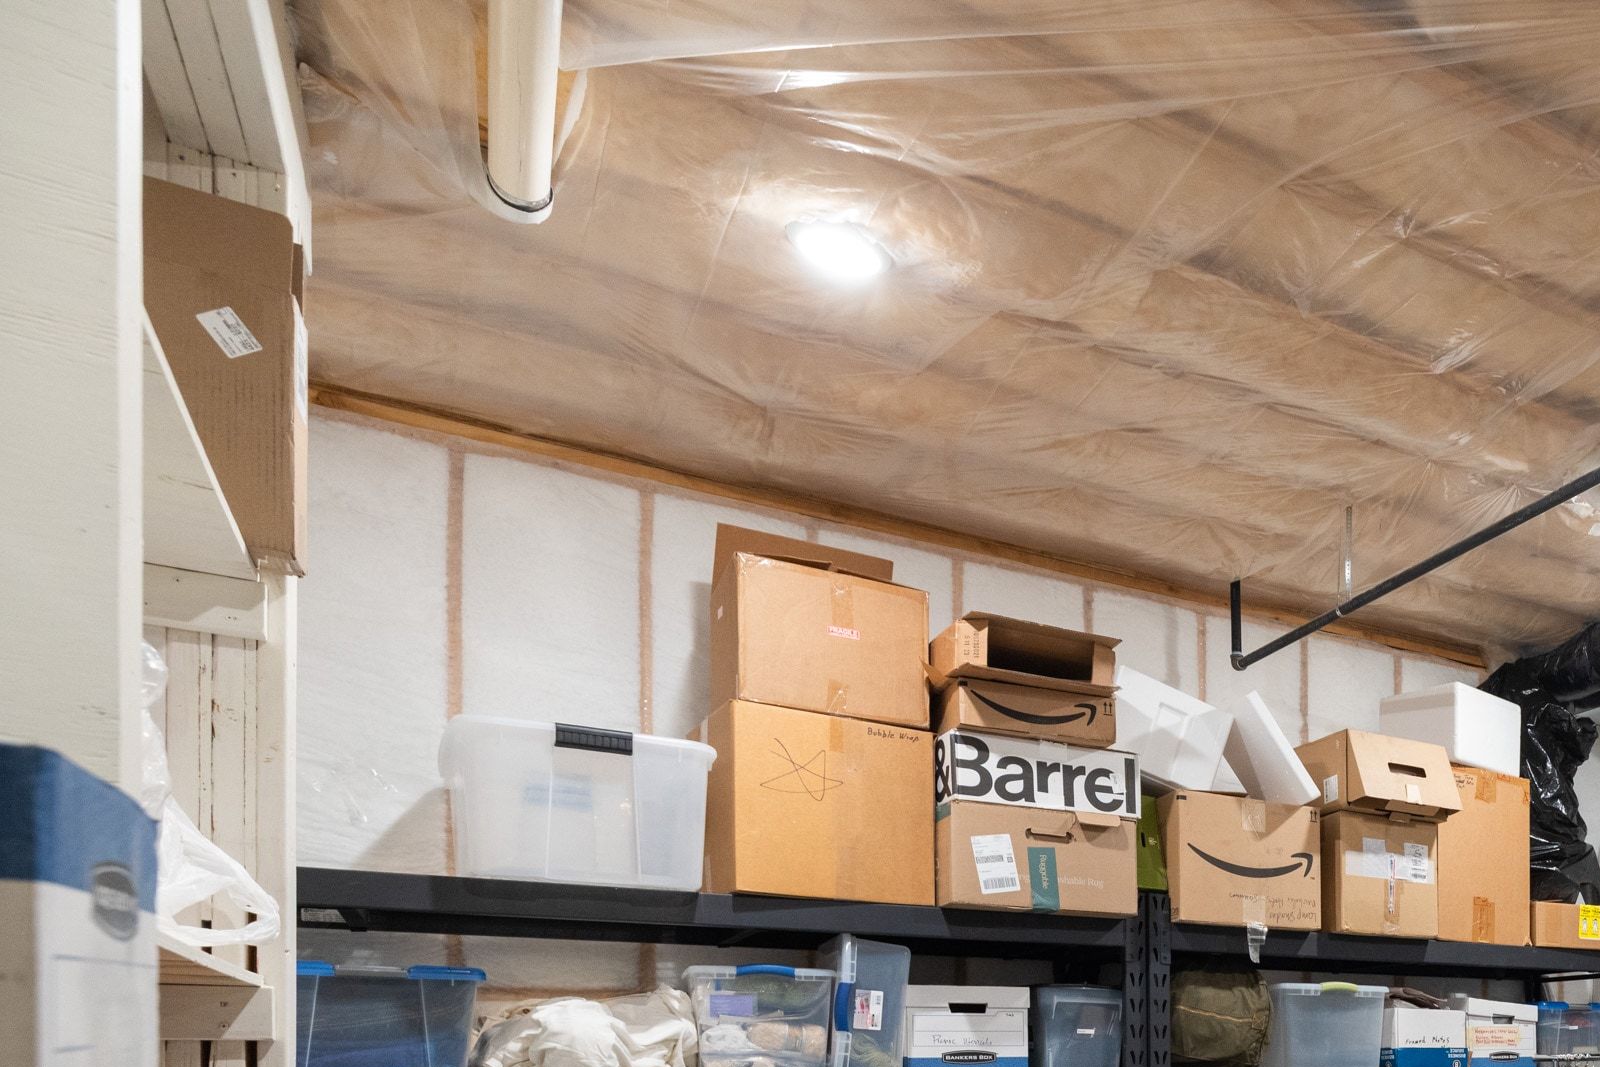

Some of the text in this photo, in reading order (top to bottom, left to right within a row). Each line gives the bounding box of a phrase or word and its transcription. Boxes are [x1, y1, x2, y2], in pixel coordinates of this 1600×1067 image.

[867, 727, 920, 743] Bubble Wrap
[1039, 853, 1049, 890] Ruggable
